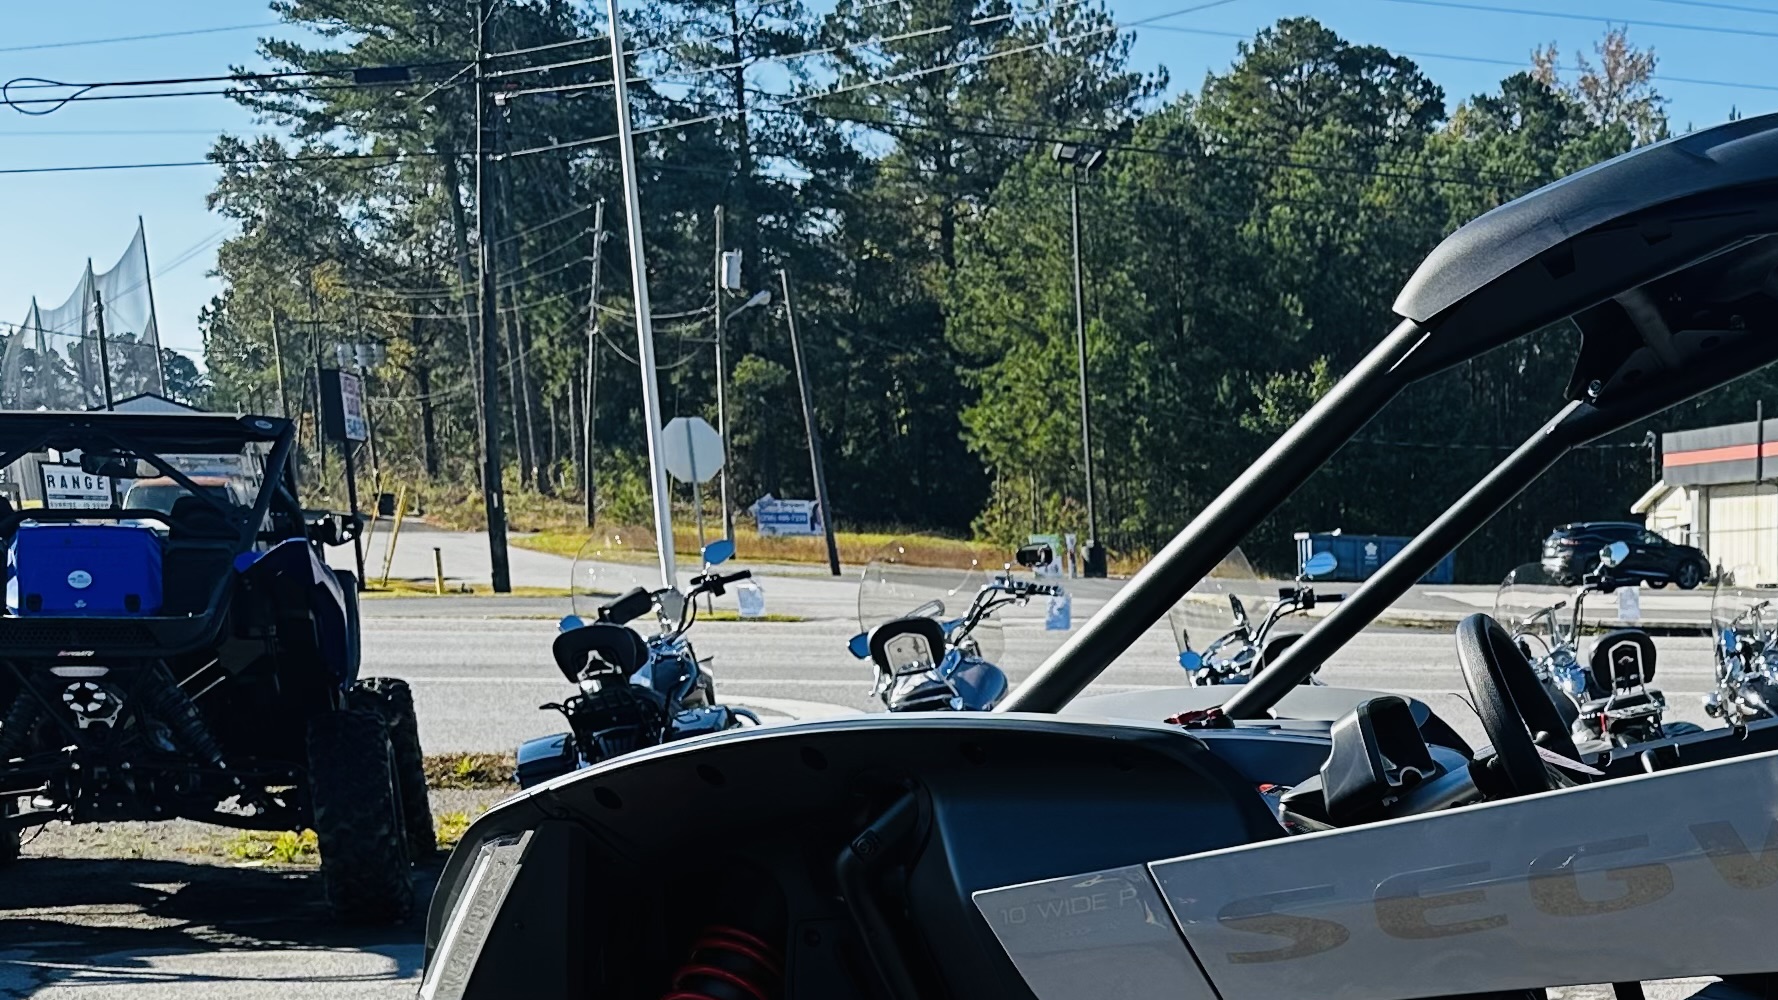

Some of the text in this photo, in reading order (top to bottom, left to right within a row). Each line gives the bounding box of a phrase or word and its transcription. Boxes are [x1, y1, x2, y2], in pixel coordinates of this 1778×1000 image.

[46, 474, 105, 490] RANGE
[1000, 906, 1027, 925] 10
[1037, 892, 1112, 919] WIDE
